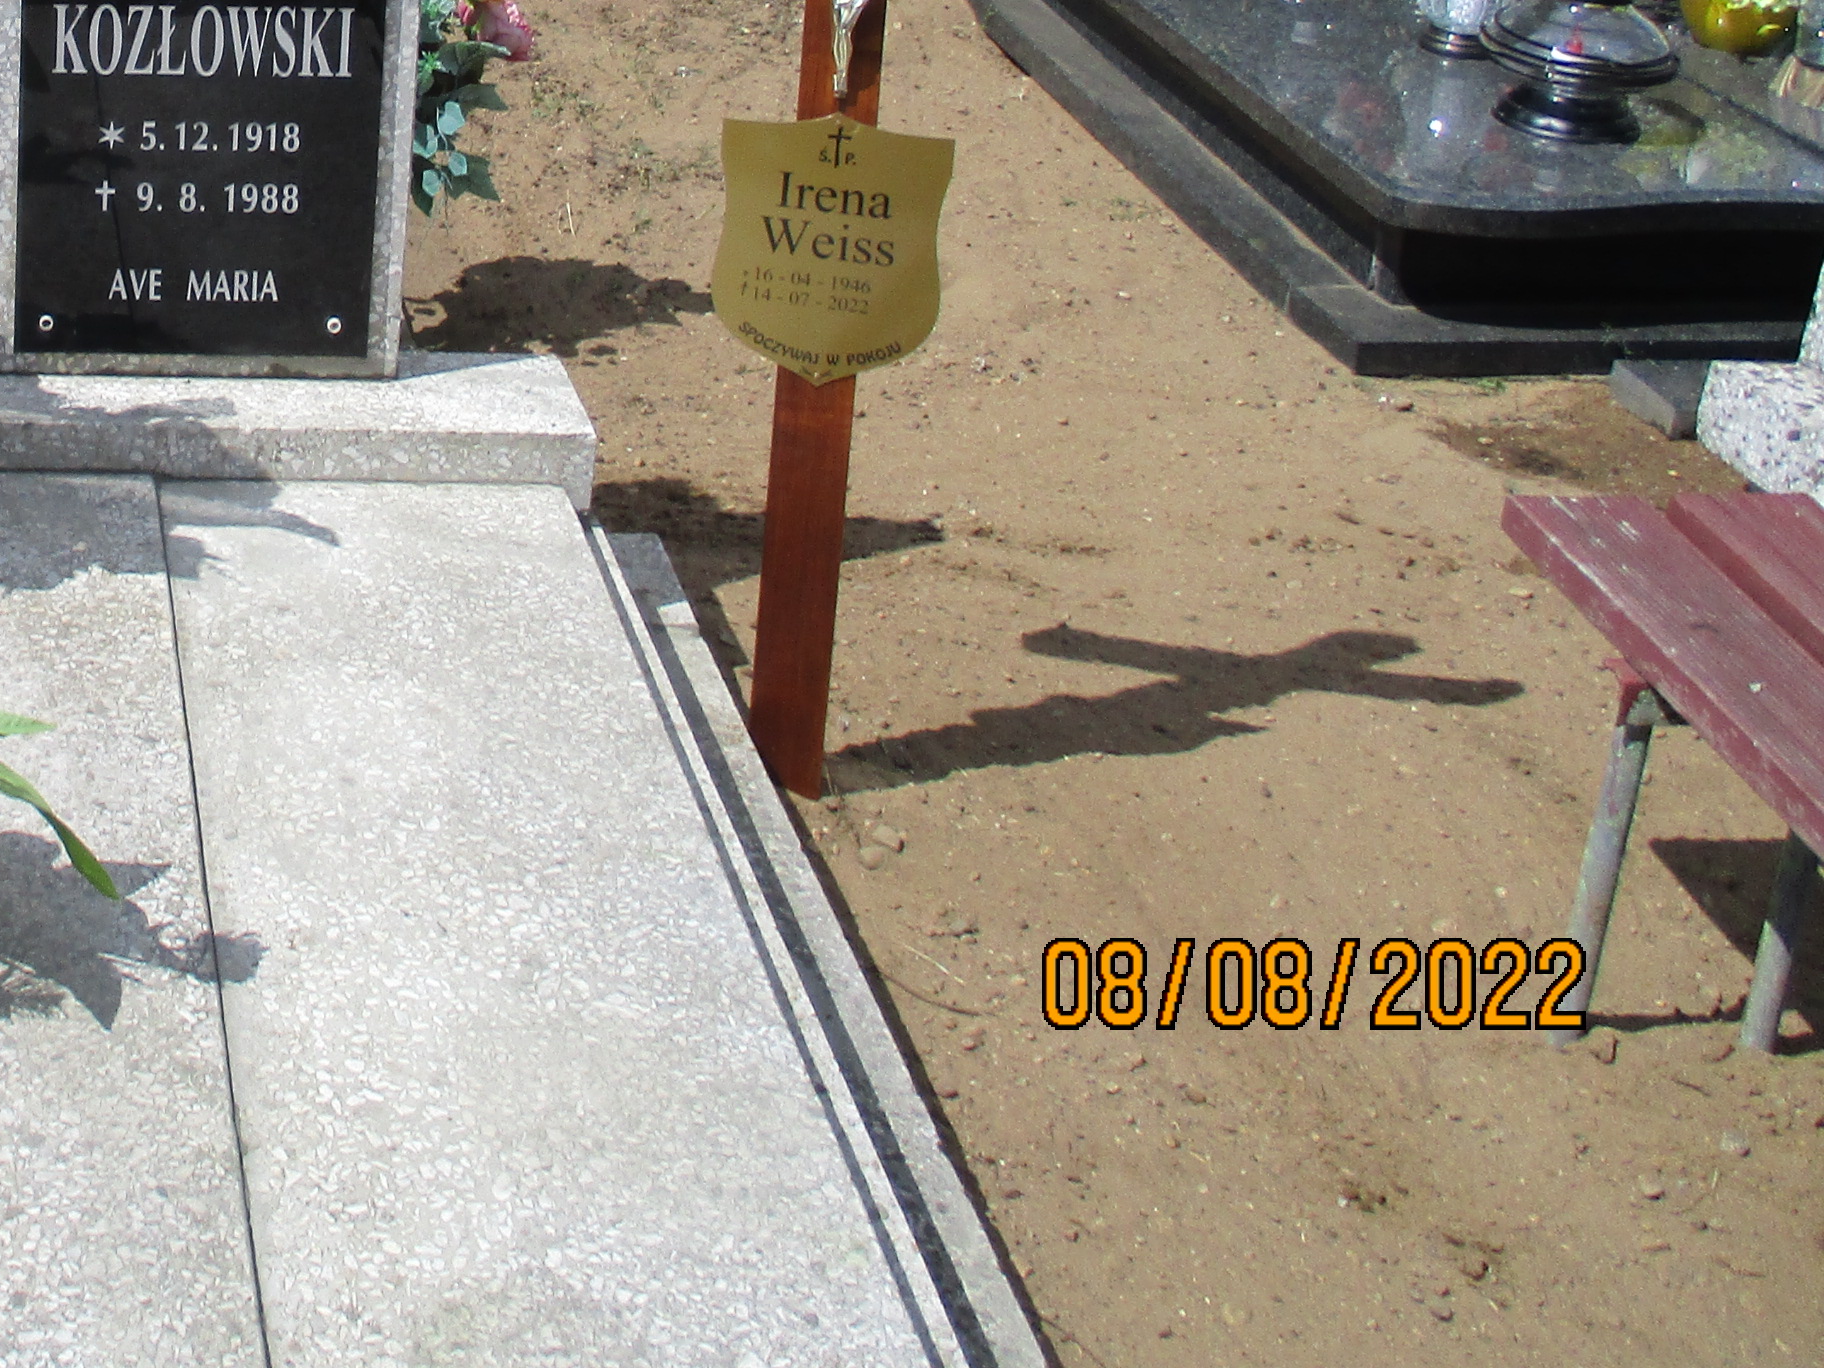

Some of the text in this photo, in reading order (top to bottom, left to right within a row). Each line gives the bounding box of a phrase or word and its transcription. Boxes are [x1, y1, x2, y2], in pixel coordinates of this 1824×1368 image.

[51, 3, 356, 79] KOZŁOWSKI
[776, 170, 893, 221] Irena
[761, 214, 896, 268] Weiss
[107, 267, 280, 303] AVE MARIA
[738, 321, 903, 367] SPOCZYWAJ W POKOJU
